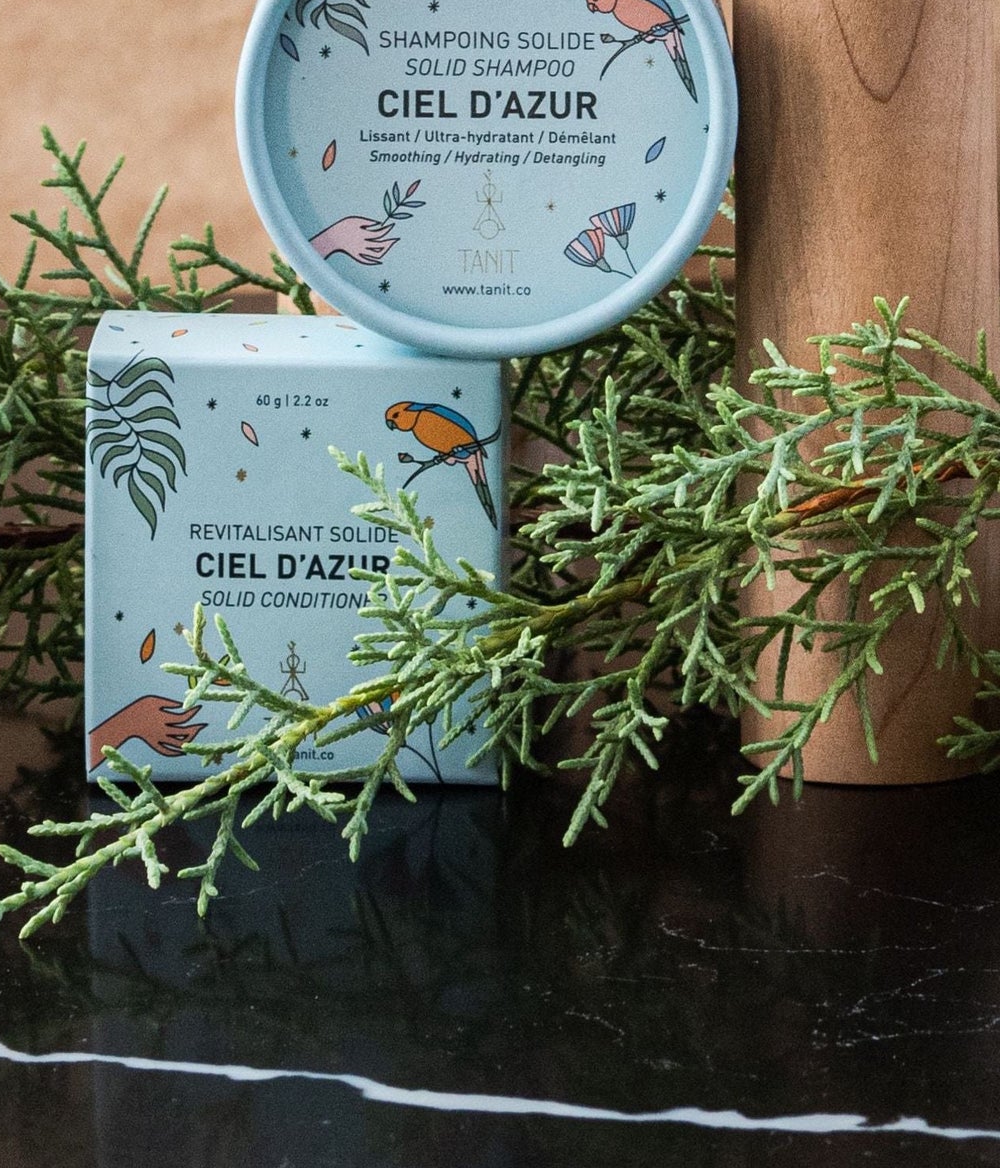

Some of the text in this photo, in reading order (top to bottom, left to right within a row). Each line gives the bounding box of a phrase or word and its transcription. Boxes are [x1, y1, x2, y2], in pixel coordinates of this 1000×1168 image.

[379, 31, 595, 50] SHAMPOING SOLIDE
[405, 58, 575, 77] SOLID SHAMPOO
[378, 90, 598, 120] CIEL D'AZUR
[360, 130, 410, 143] Lissant
[425, 130, 534, 145] Ultra-hydratant
[549, 131, 616, 144] Démêlant
[370, 150, 441, 165] Smoothing
[455, 151, 520, 166] Hydrating
[533, 152, 606, 167] Detangling
[457, 249, 521, 273] TANIT
[442, 283, 531, 296] www.tanit.co
[256, 394, 271, 406] 60
[274, 397, 281, 409] g
[293, 394, 312, 406] 2.2
[315, 398, 329, 407] oz
[190, 524, 400, 543] REVITALISANT SOLIDE
[196, 552, 266, 579] CIEL
[201, 591, 256, 607] SOLID
